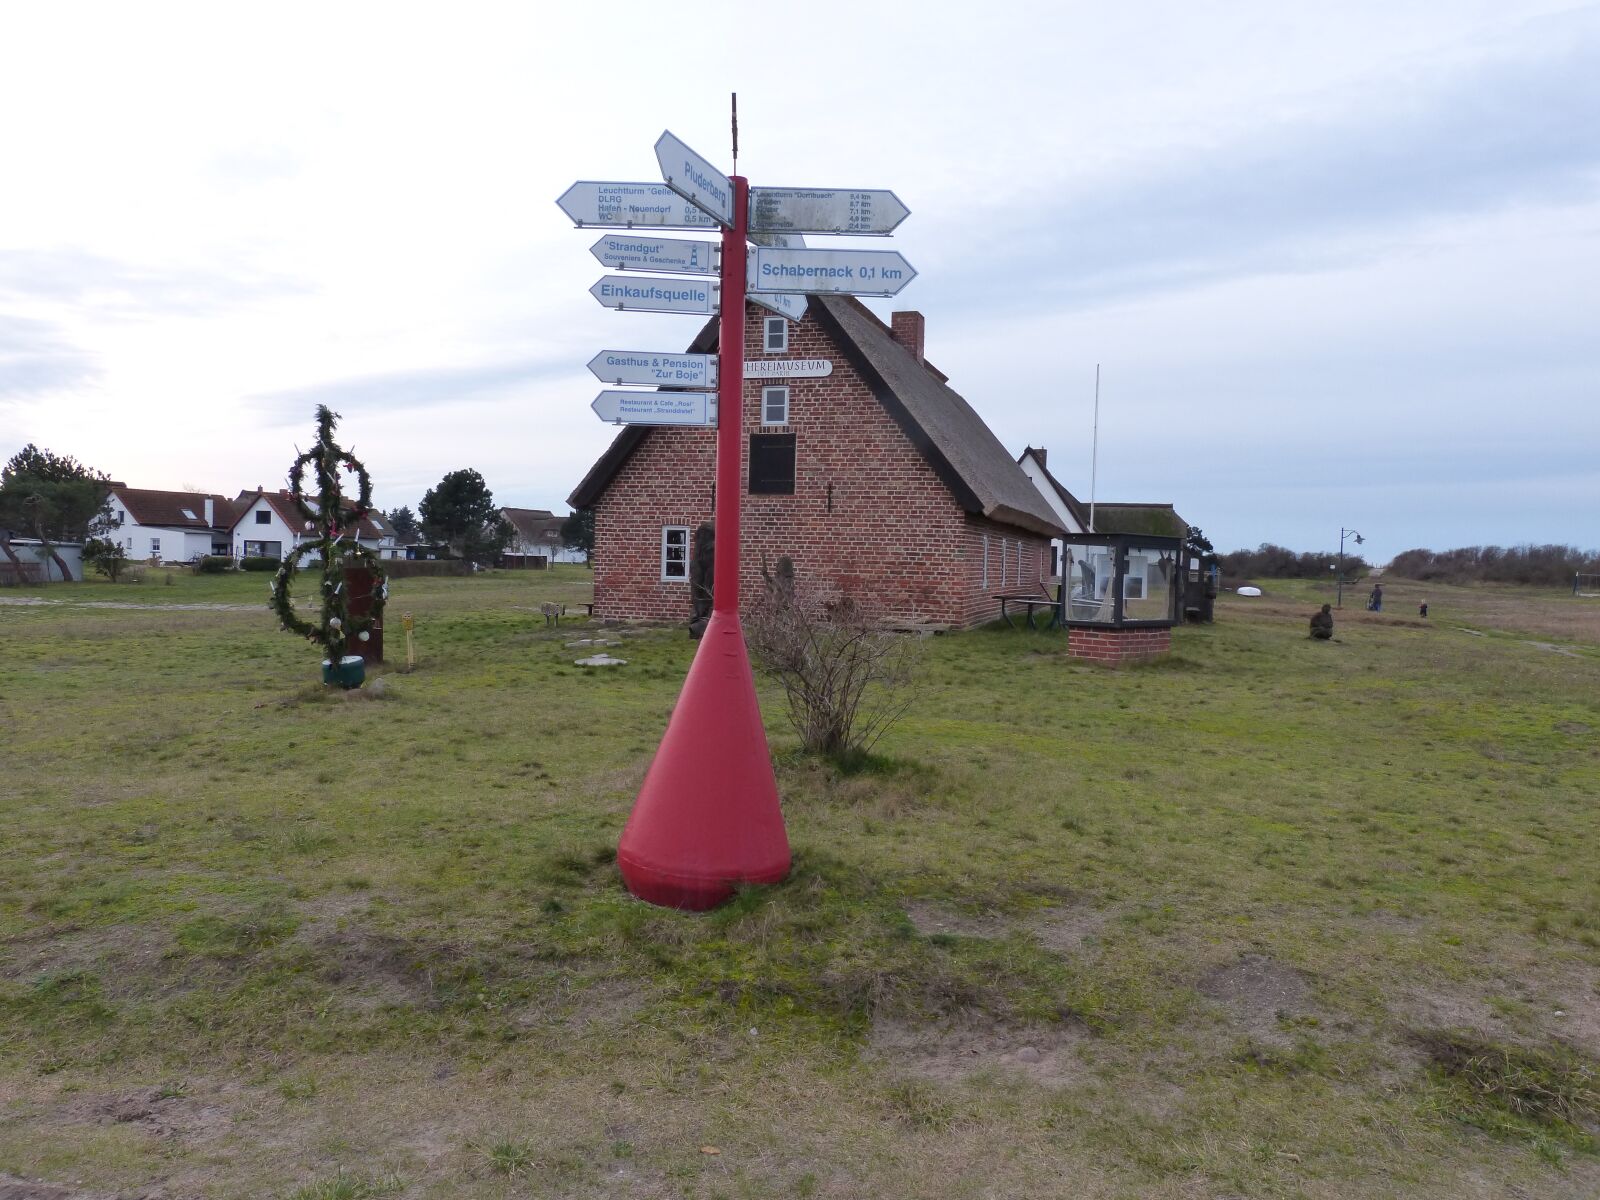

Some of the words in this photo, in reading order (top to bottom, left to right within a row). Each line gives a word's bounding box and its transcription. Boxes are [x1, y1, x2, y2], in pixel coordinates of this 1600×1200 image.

[598, 187, 644, 195] Leuchtturm
[629, 205, 671, 213] Neuendorf
[650, 256, 686, 264] Geschenke
[762, 263, 853, 278] Schabernack
[859, 267, 875, 280] 0,1
[881, 268, 902, 279] km
[601, 284, 705, 302] Einkaufsquelle
[607, 356, 648, 366] Gasthus
[663, 359, 703, 368] Pension
[746, 361, 825, 371] HEREIMUSEUM
